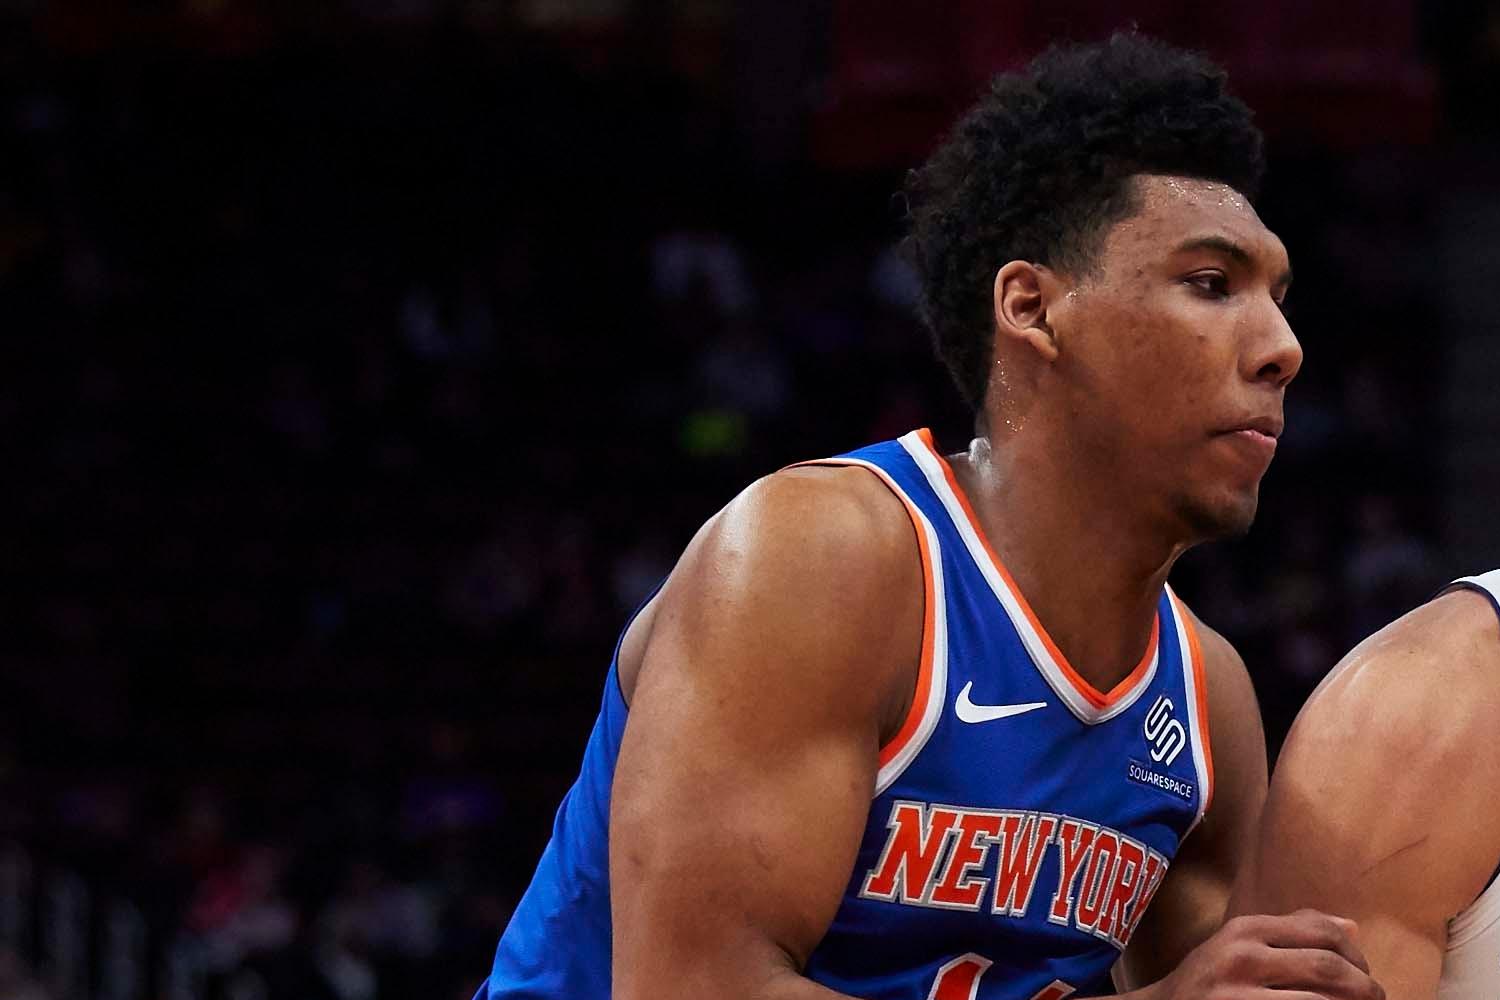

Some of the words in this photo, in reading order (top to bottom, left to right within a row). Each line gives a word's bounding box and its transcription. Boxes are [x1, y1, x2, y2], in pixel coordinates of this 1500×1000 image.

[1129, 764, 1192, 798] SQUARESPACE
[858, 801, 1057, 918] NEW
[1047, 814, 1170, 951] YORK
